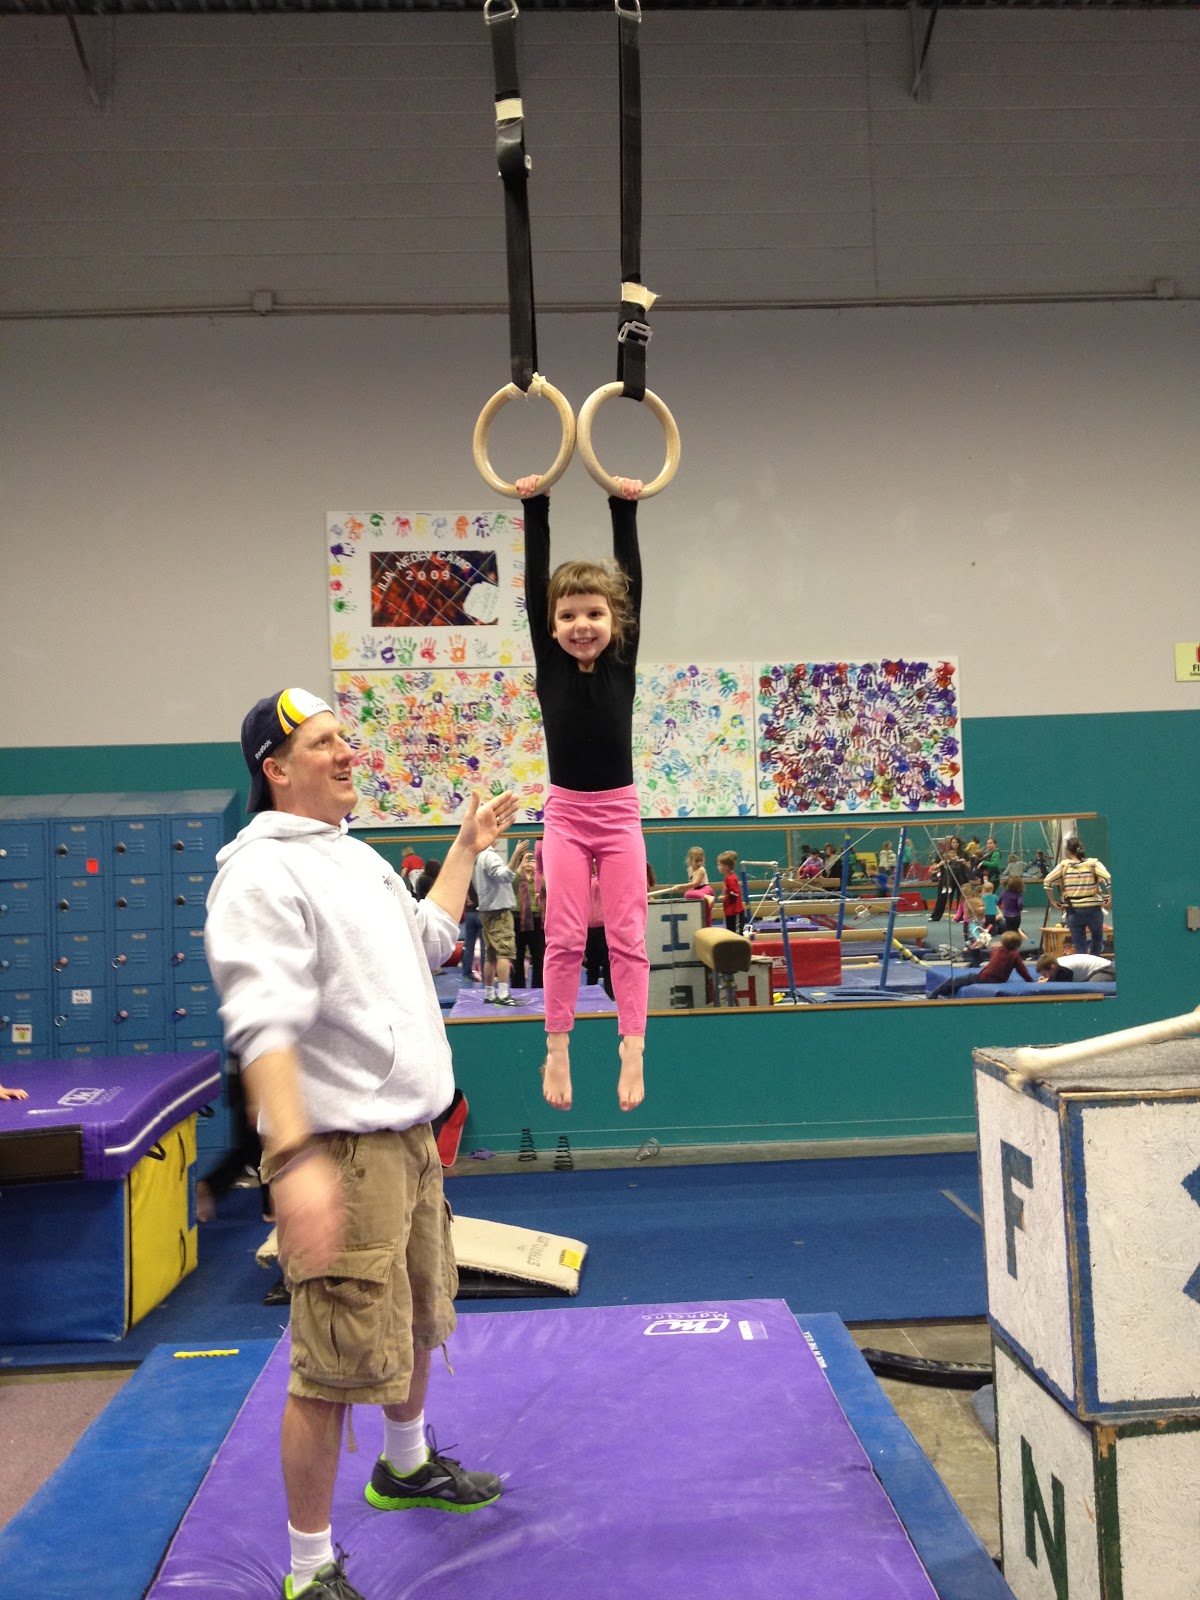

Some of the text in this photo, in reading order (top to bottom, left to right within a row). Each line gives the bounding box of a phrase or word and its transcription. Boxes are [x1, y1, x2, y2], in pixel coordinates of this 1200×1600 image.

[437, 551, 472, 570] CAMP
[405, 570, 450, 581] 2009
[447, 704, 487, 716] STARS
[418, 761, 448, 771] 2009
[1000, 1138, 1034, 1281] F
[1021, 1434, 1069, 1600] N
